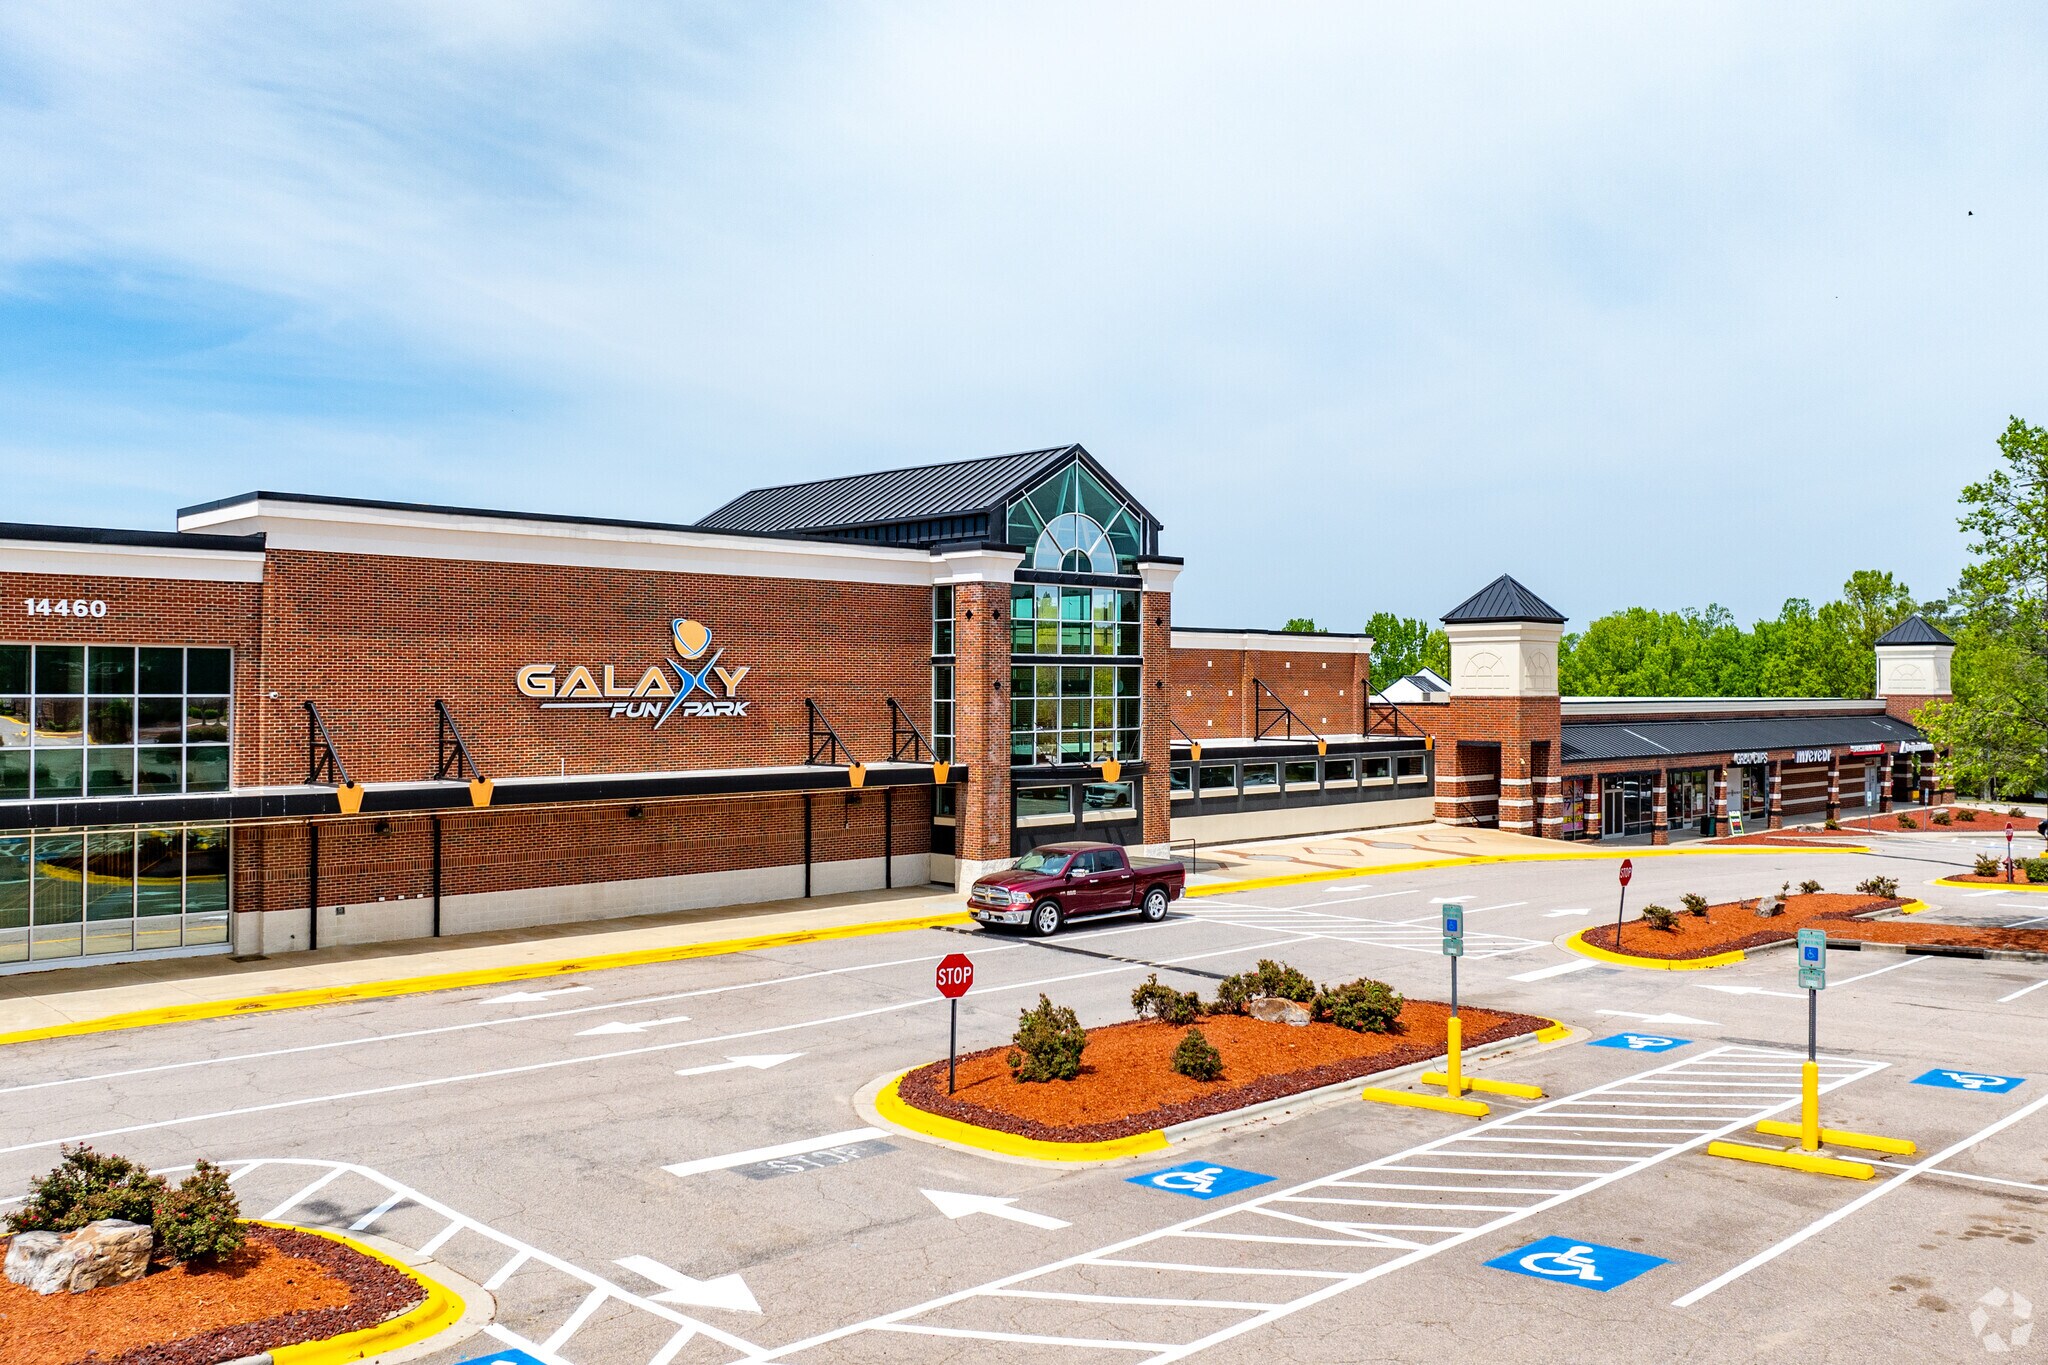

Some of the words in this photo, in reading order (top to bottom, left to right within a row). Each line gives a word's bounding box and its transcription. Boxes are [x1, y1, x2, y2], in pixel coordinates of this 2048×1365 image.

[24, 598, 107, 618] 14460
[517, 648, 751, 698] GALAXY
[610, 702, 663, 719] FUN
[682, 701, 751, 717] PARK
[938, 966, 972, 986] STOP
